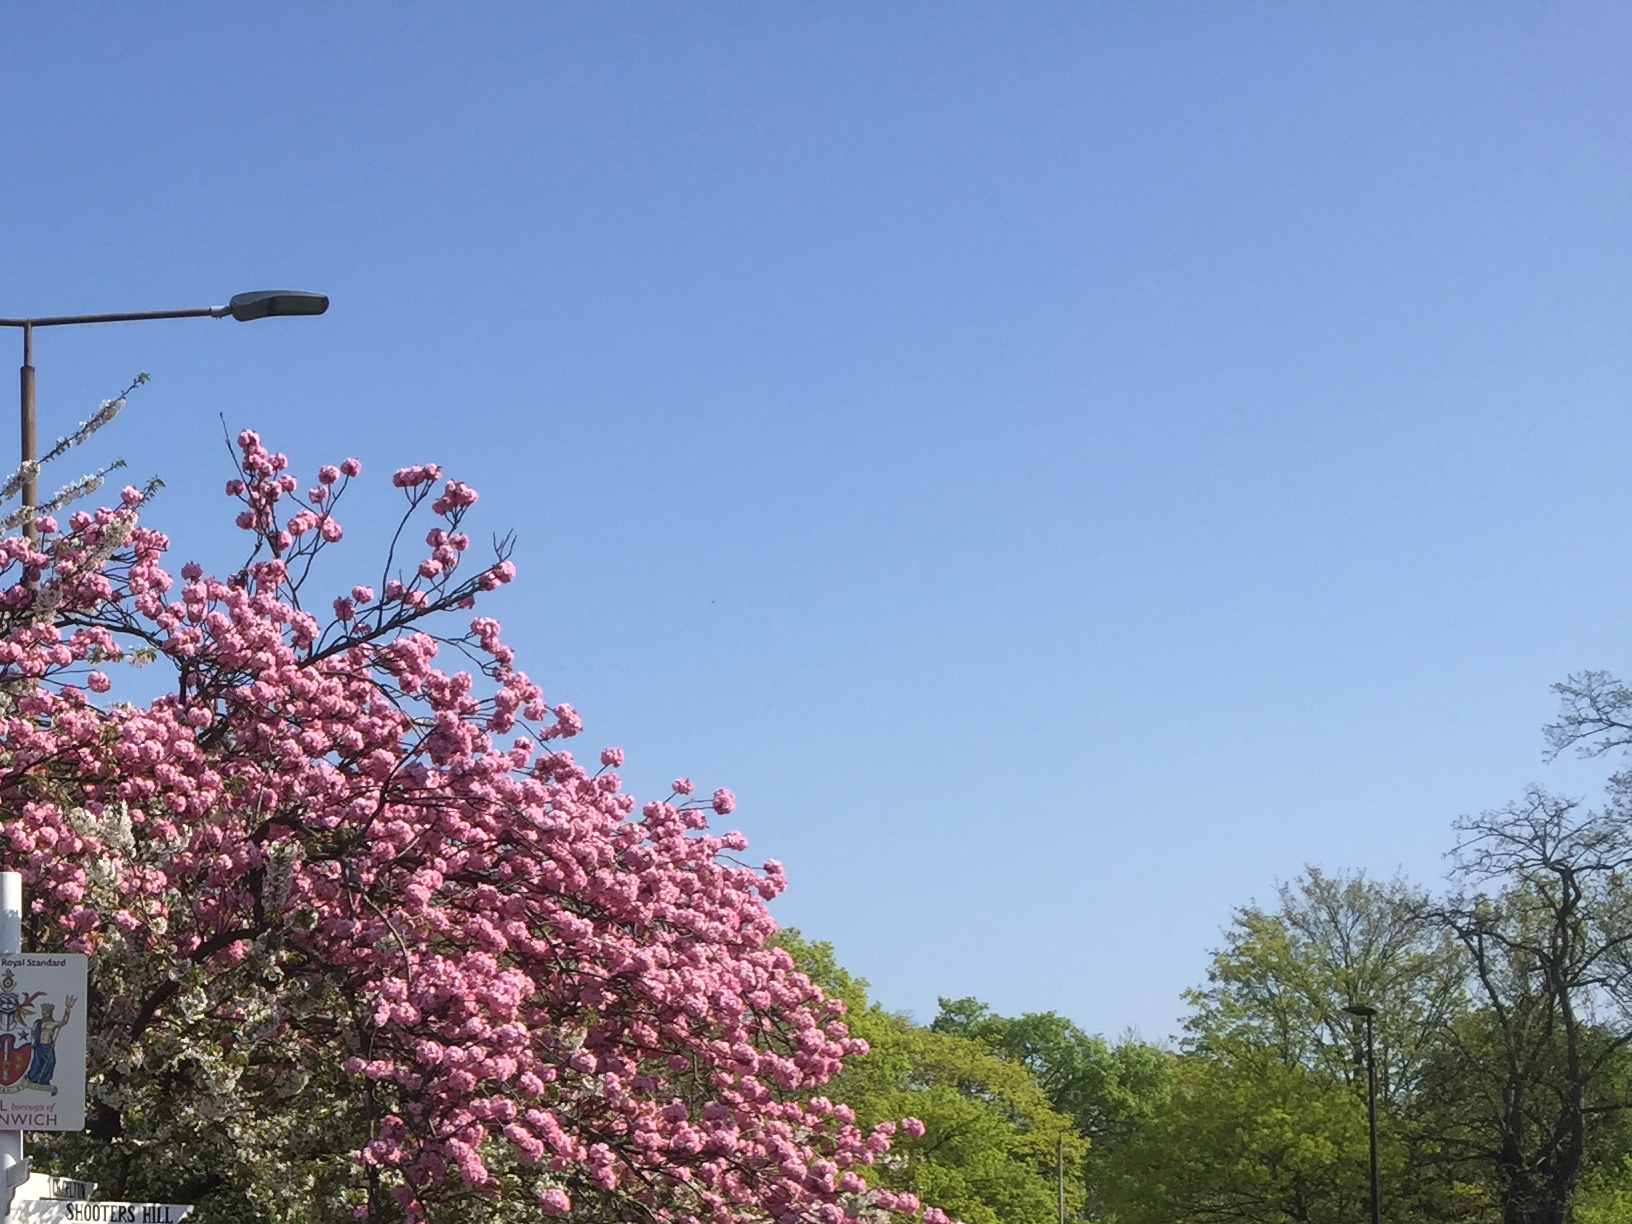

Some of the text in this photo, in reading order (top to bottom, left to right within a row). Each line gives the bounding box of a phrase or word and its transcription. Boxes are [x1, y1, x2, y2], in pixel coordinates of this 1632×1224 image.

[1, 958, 25, 969] Royal
[27, 958, 66, 967] Standard
[11, 1102, 45, 1113] borough
[47, 1102, 56, 1112] of
[66, 1202, 173, 1224] SHOOTERS HILL
